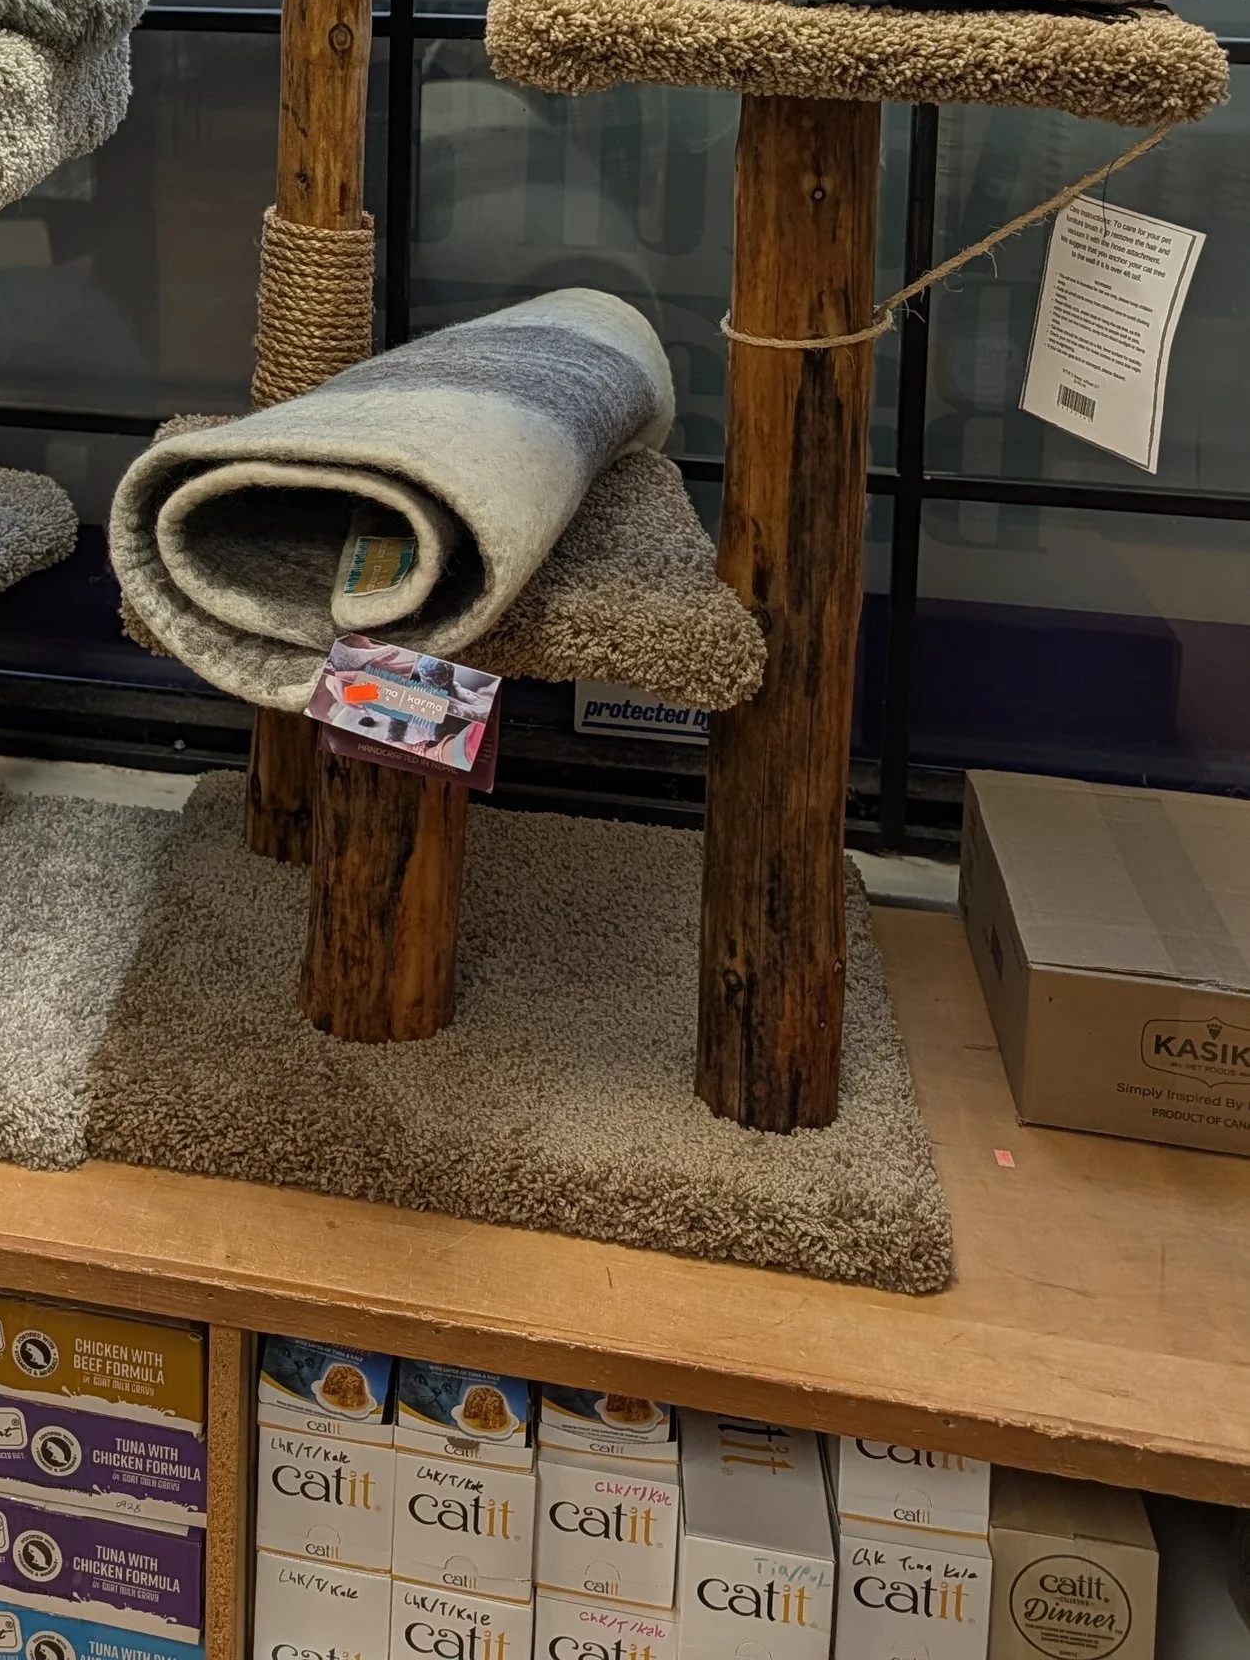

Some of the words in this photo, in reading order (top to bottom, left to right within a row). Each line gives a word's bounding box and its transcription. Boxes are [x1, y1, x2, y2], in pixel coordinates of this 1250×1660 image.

[1122, 224, 1137, 234] care
[1137, 226, 1147, 237] for
[1147, 231, 1162, 243] your
[1161, 235, 1172, 245] pet
[407, 694, 444, 713] karma
[584, 698, 688, 729] protected
[357, 743, 419, 765] HANDCRAFTED
[420, 758, 432, 768] IN
[1116, 1082, 1163, 1100] Simply
[1167, 1090, 1221, 1107] Inspired
[1226, 1098, 1243, 1111] By
[1152, 1107, 1205, 1123] PRODUCT
[1206, 1115, 1222, 1125] OF
[75, 1338, 129, 1359] CHICKEN
[131, 1348, 164, 1368] WITH
[73, 1354, 103, 1373] BEEF
[105, 1361, 165, 1385] FORMULA
[115, 1438, 146, 1457] TUNA
[148, 1443, 178, 1462] WITH
[92, 1449, 144, 1471] CHICKEN
[146, 1459, 201, 1482] FORMULA
[271, 1463, 376, 1511] catit
[408, 1493, 516, 1541] catit
[549, 1500, 658, 1547] catit
[893, 1508, 932, 1525] catit
[96, 1545, 126, 1564] TUNA
[129, 1552, 159, 1572] WITH
[305, 1542, 340, 1559] catit
[73, 1556, 123, 1580] CHICKEN
[125, 1567, 181, 1594] FORMULA
[583, 1579, 619, 1595] catit
[1039, 1574, 1106, 1601] catit
[697, 1577, 812, 1627] catit
[853, 1576, 970, 1623] catit
[1024, 1597, 1117, 1632] Dinner
[404, 1622, 511, 1660] catit
